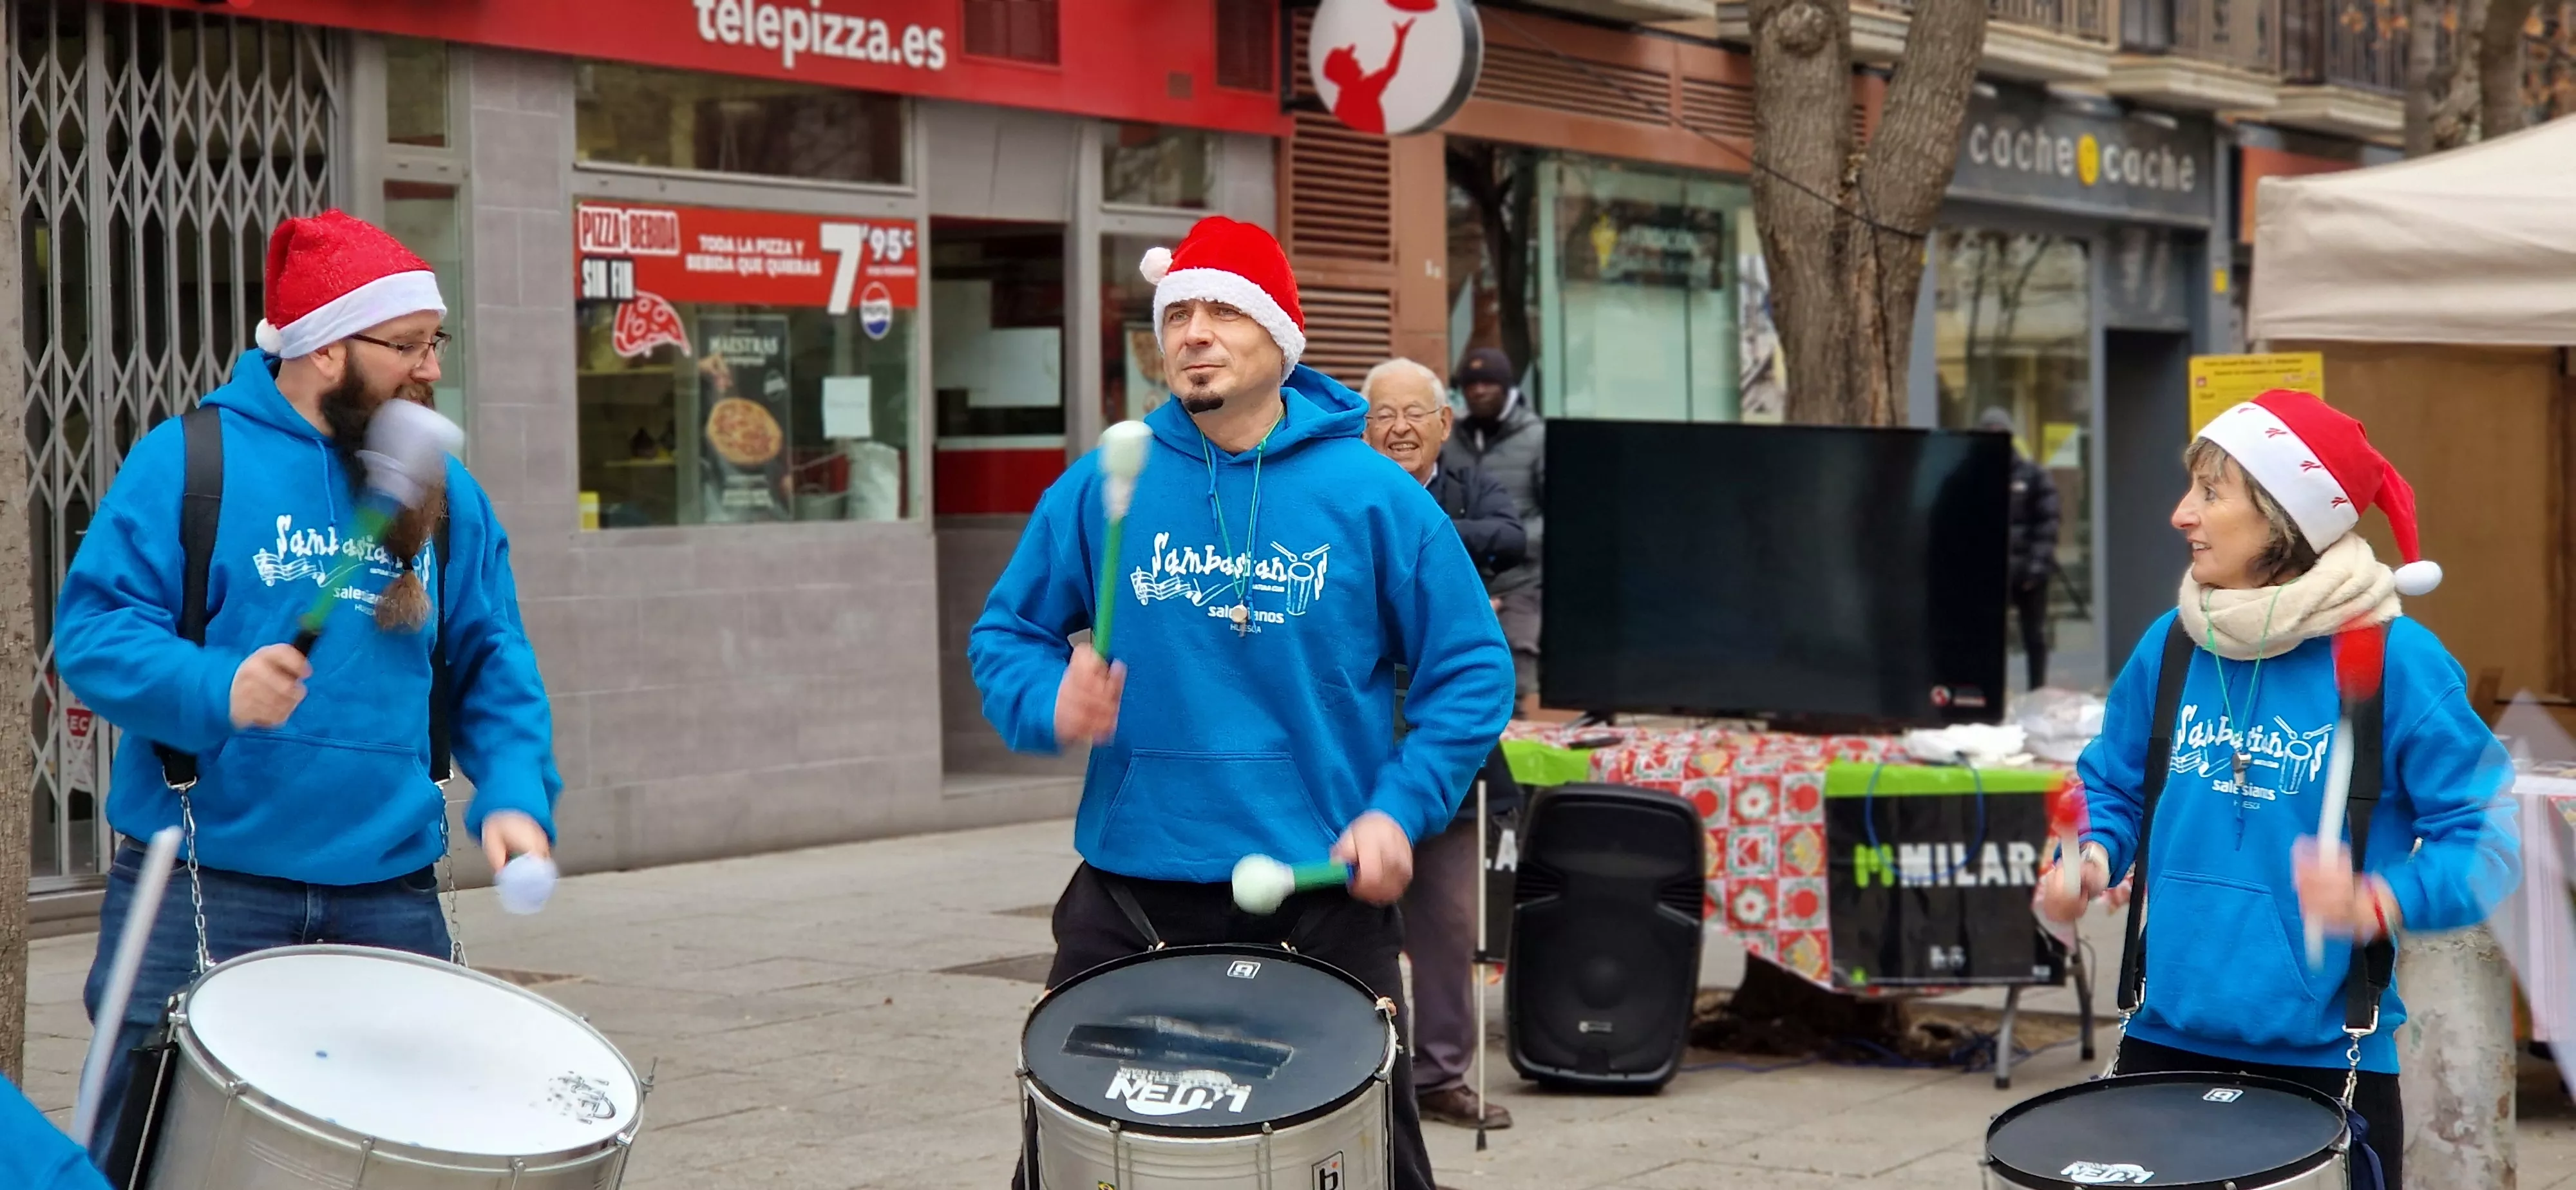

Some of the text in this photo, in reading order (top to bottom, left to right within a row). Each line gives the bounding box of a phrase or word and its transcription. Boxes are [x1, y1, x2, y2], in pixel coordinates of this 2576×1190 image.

[693, 0, 947, 70] telepizza.es
[1969, 123, 2195, 193] cache cache
[582, 209, 621, 248] PIZZA
[698, 234, 734, 252] TODA
[736, 237, 753, 254] LA
[755, 238, 793, 255] PIZZA
[582, 259, 634, 299] SIN FIN
[737, 256, 764, 277] QUE
[766, 258, 822, 278] QUIERAS
[1899, 842, 2037, 888] MILAR
